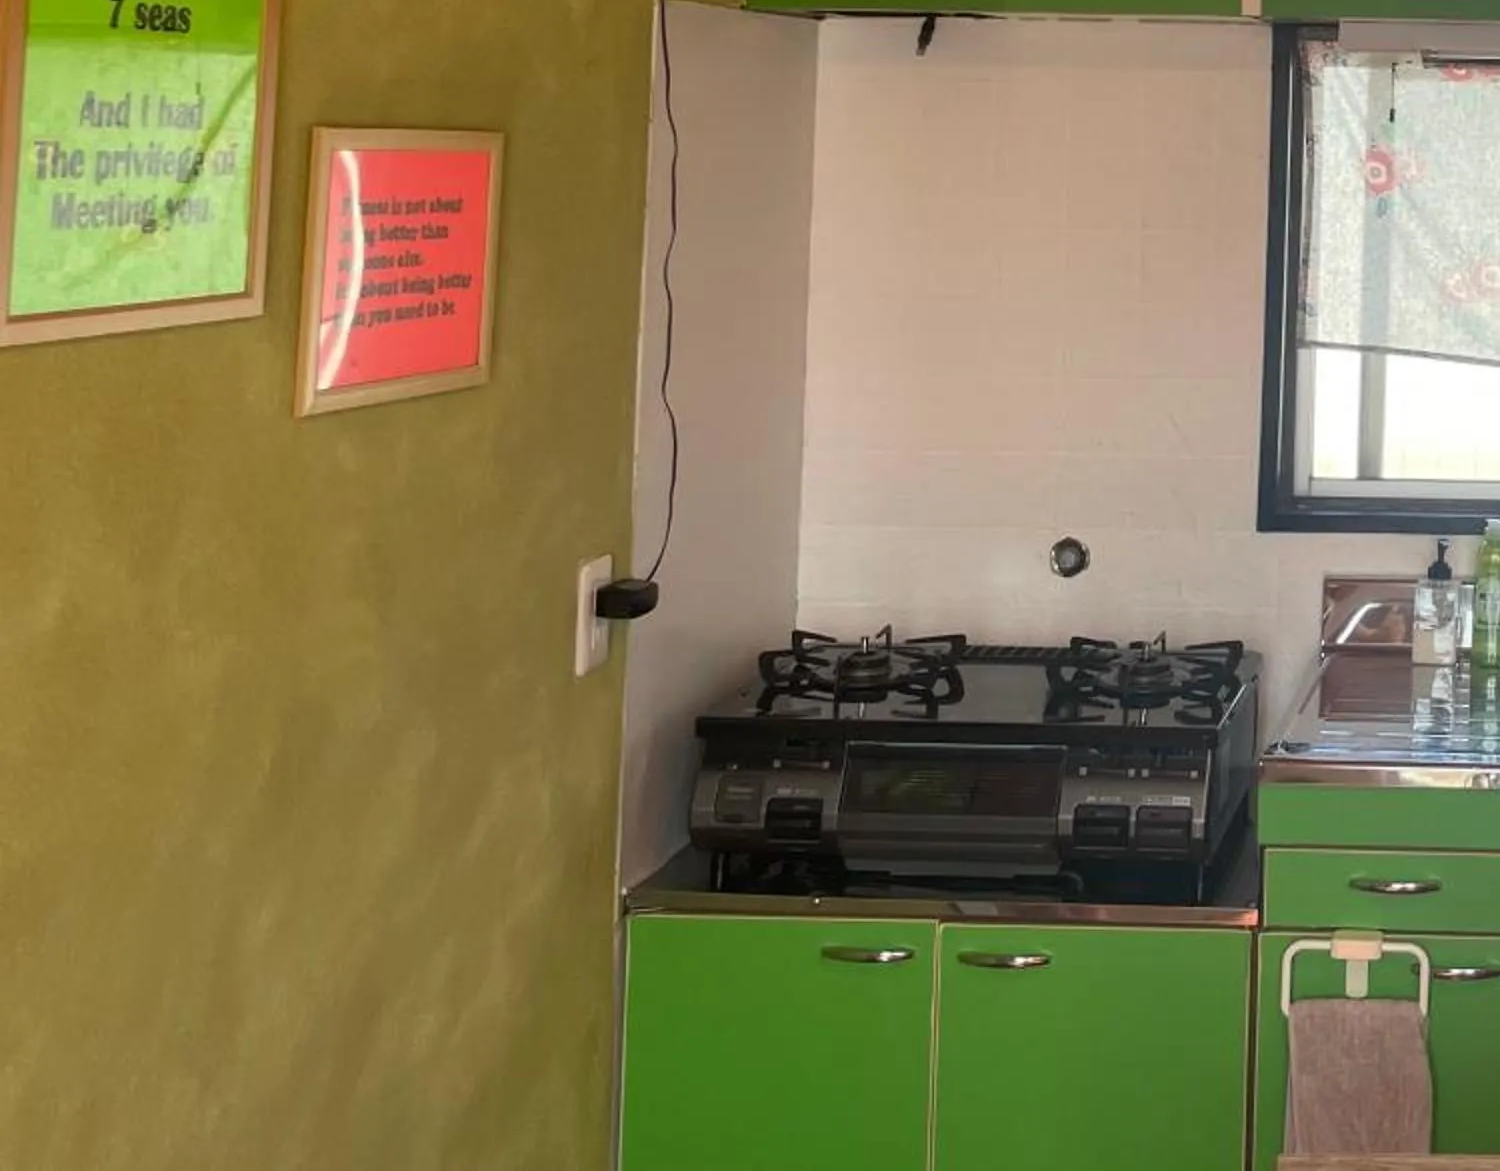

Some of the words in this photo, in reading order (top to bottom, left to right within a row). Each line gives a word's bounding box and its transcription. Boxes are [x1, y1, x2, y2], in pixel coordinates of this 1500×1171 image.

[133, 1, 193, 34] seas
[79, 90, 131, 129] And
[140, 94, 150, 128] I
[158, 91, 205, 130] had
[34, 140, 85, 180] The
[96, 141, 205, 185] privilege
[213, 143, 239, 177] of
[50, 191, 158, 234] Meeting
[391, 196, 403, 215] is
[405, 199, 427, 215] not
[429, 196, 463, 214] about
[379, 223, 418, 241] better
[421, 222, 449, 240] than
[402, 276, 435, 295] being
[437, 274, 472, 290] better
[367, 309, 393, 328] you
[427, 301, 439, 317] to
[441, 299, 456, 316] be
